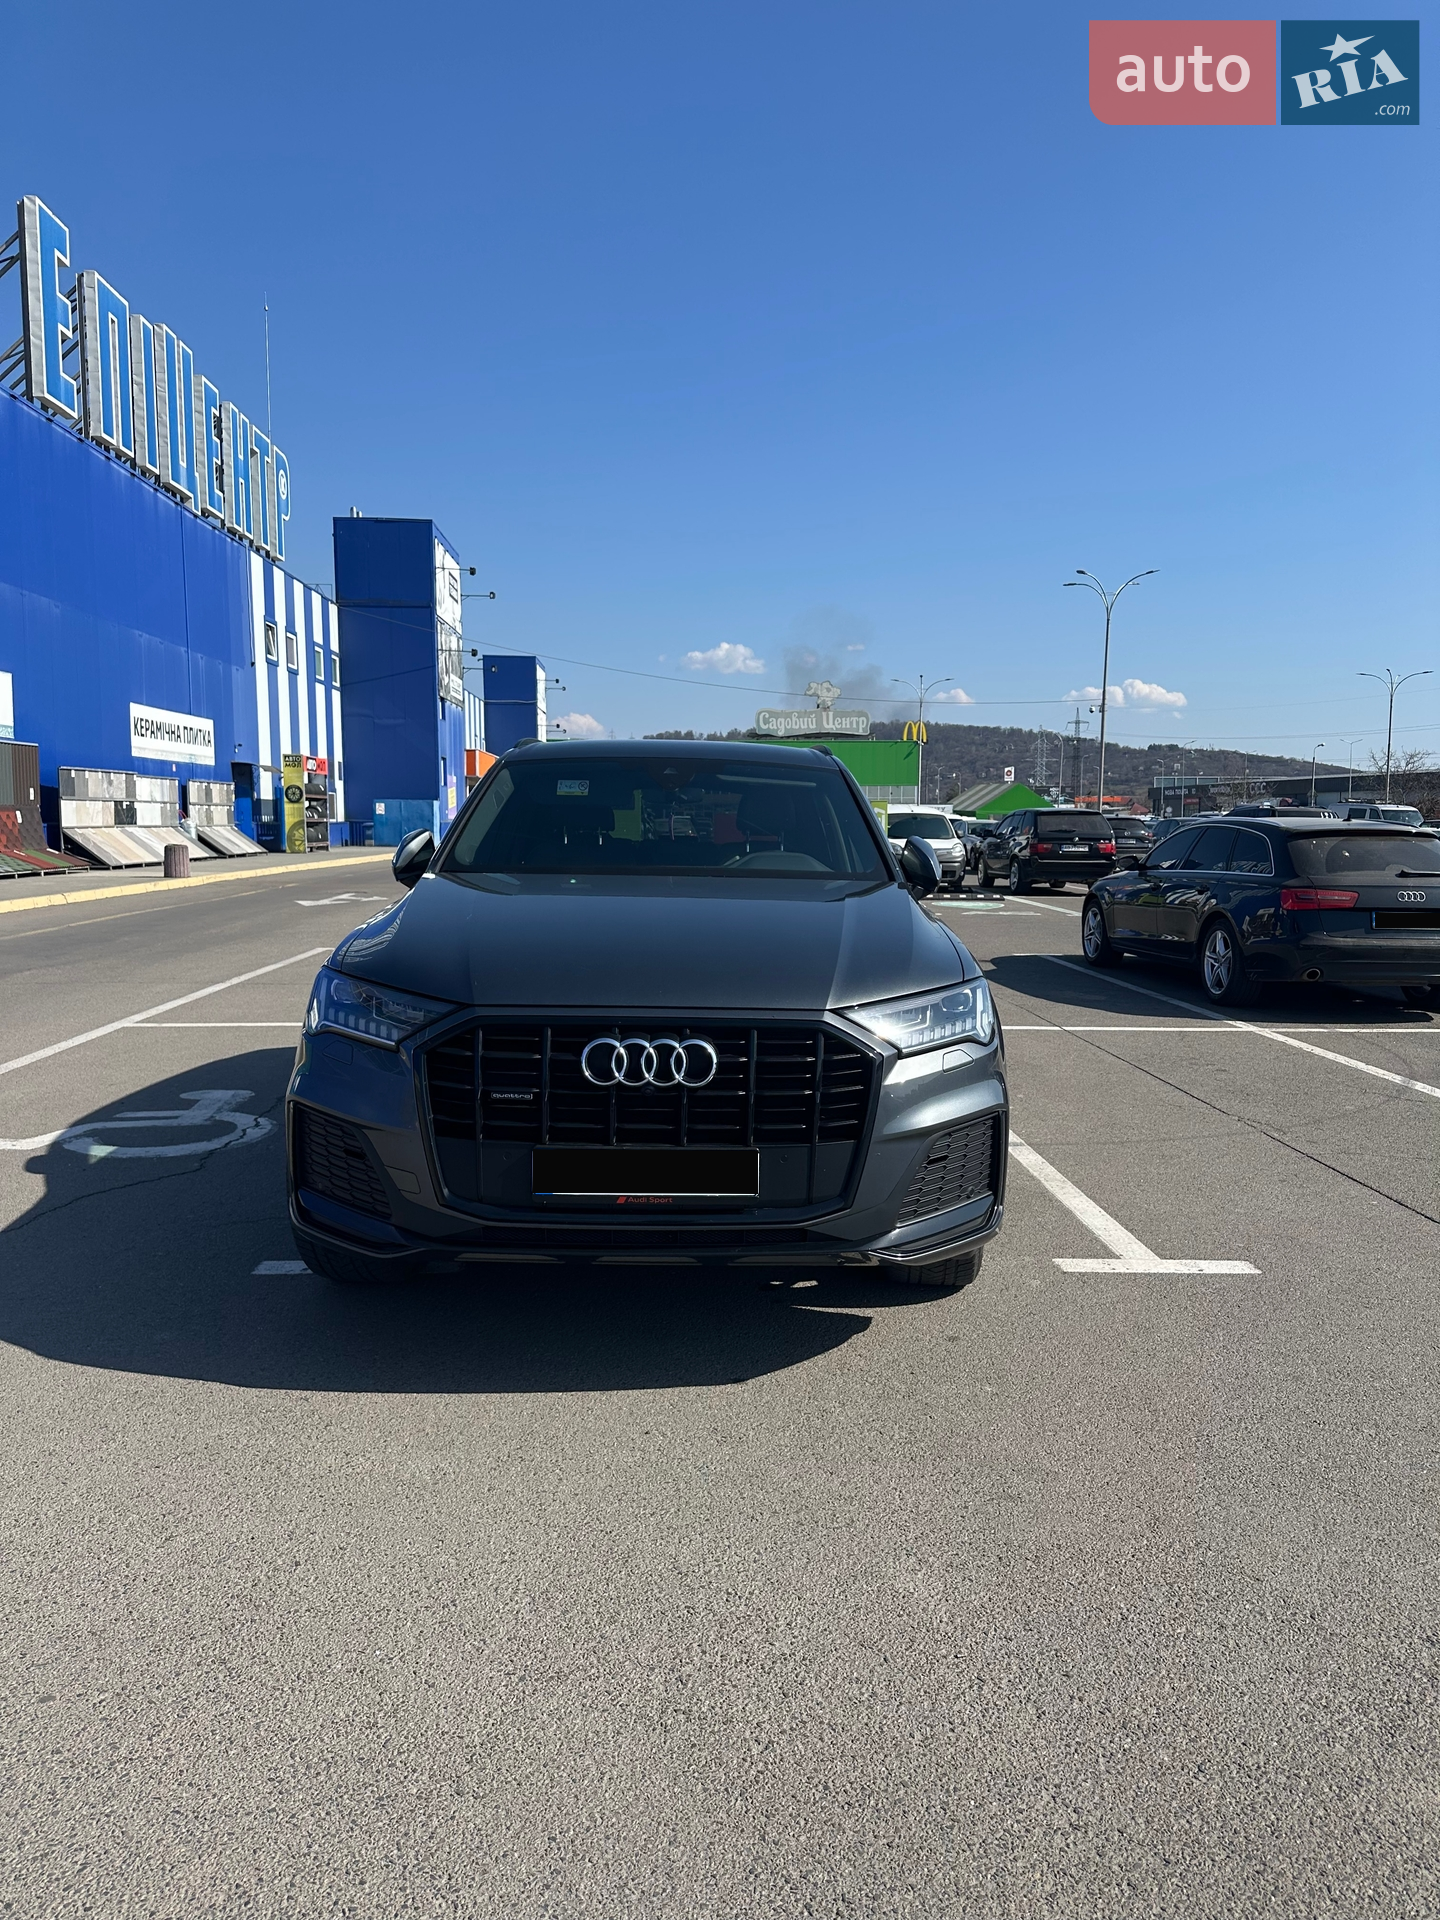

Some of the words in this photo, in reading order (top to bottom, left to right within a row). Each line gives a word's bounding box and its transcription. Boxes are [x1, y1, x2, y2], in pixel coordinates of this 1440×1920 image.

[133, 716, 182, 743] КЕРАМІЧНА
[183, 725, 212, 748] ПЛИТКА
[759, 711, 817, 734] Садовий
[822, 711, 867, 734] Центр
[492, 1092, 532, 1100] quattro
